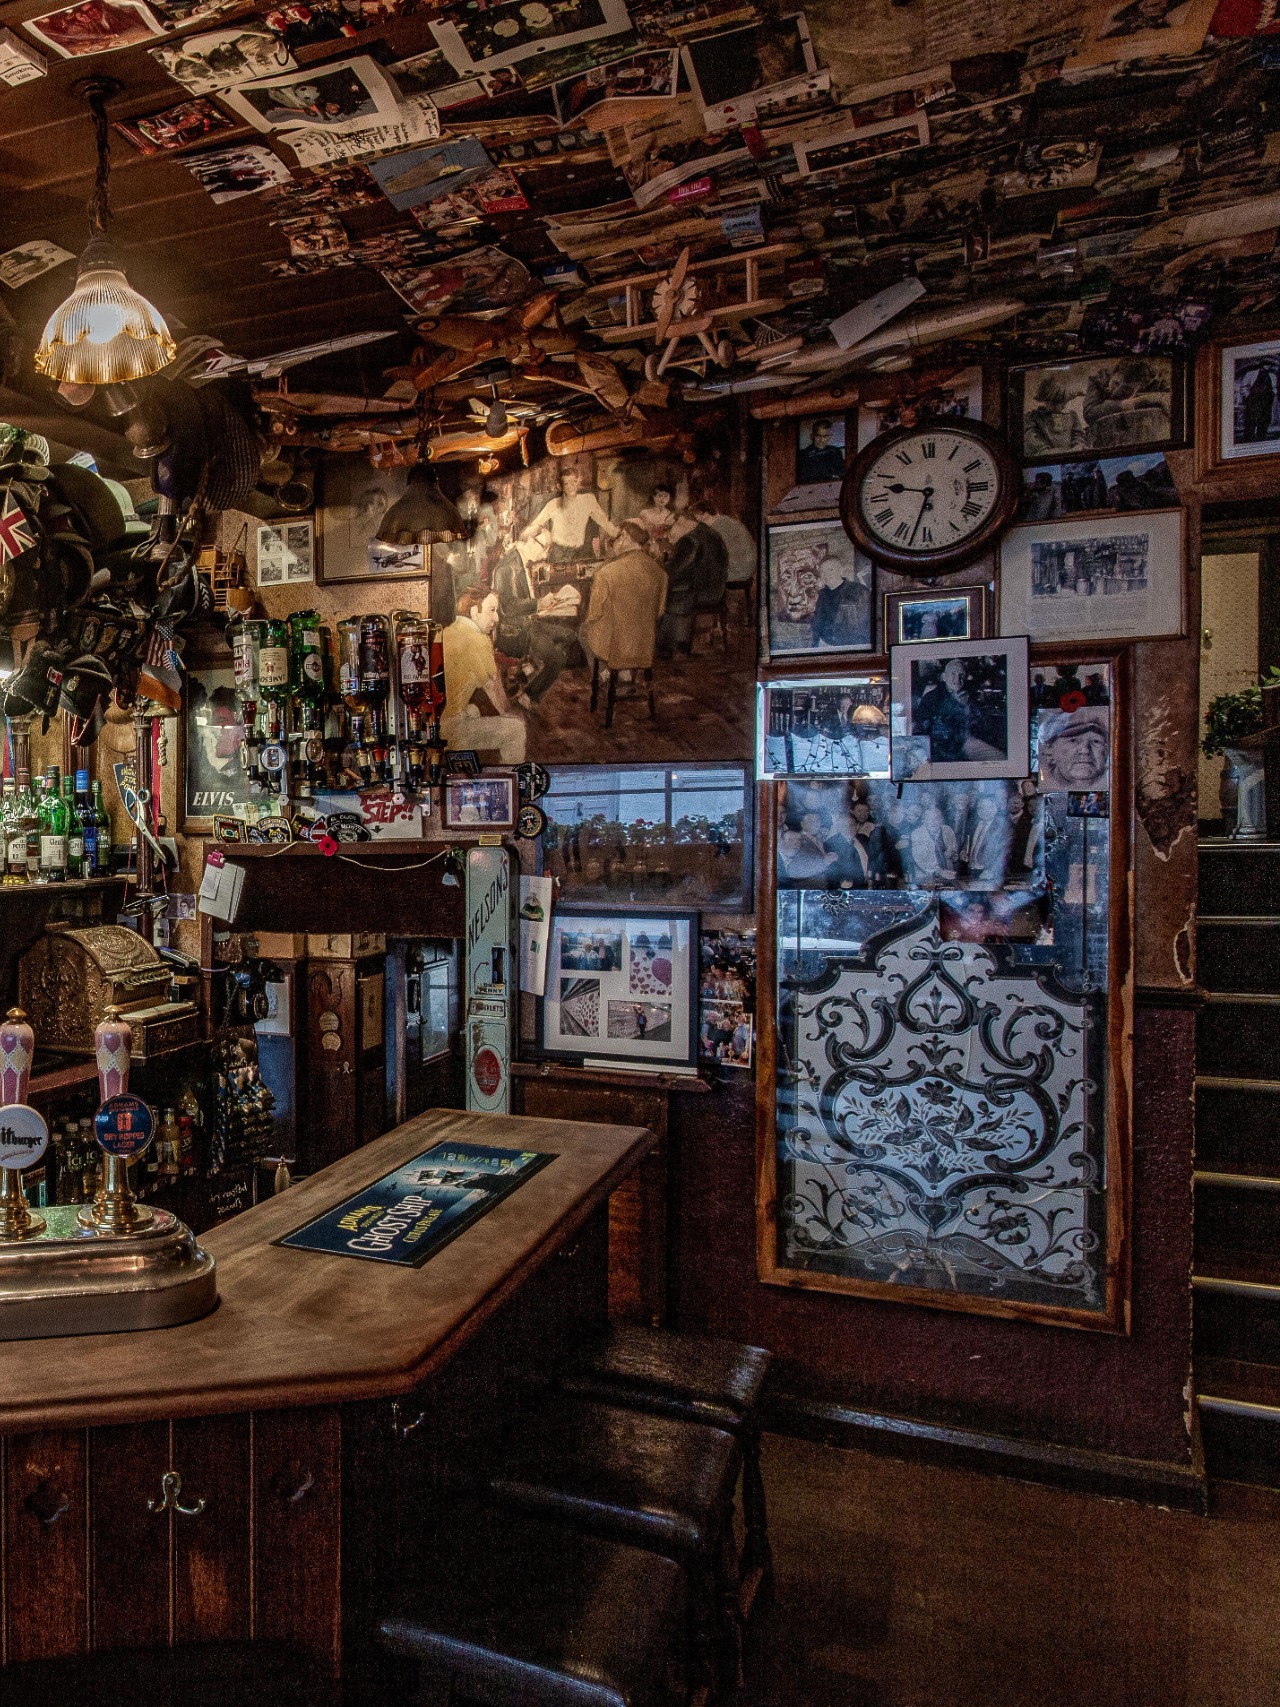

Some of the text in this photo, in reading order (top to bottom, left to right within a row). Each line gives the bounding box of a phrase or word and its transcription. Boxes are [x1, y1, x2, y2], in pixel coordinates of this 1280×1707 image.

[192, 791, 235, 806] ELVIS
[346, 1195, 434, 1252] GHOST SHIP
